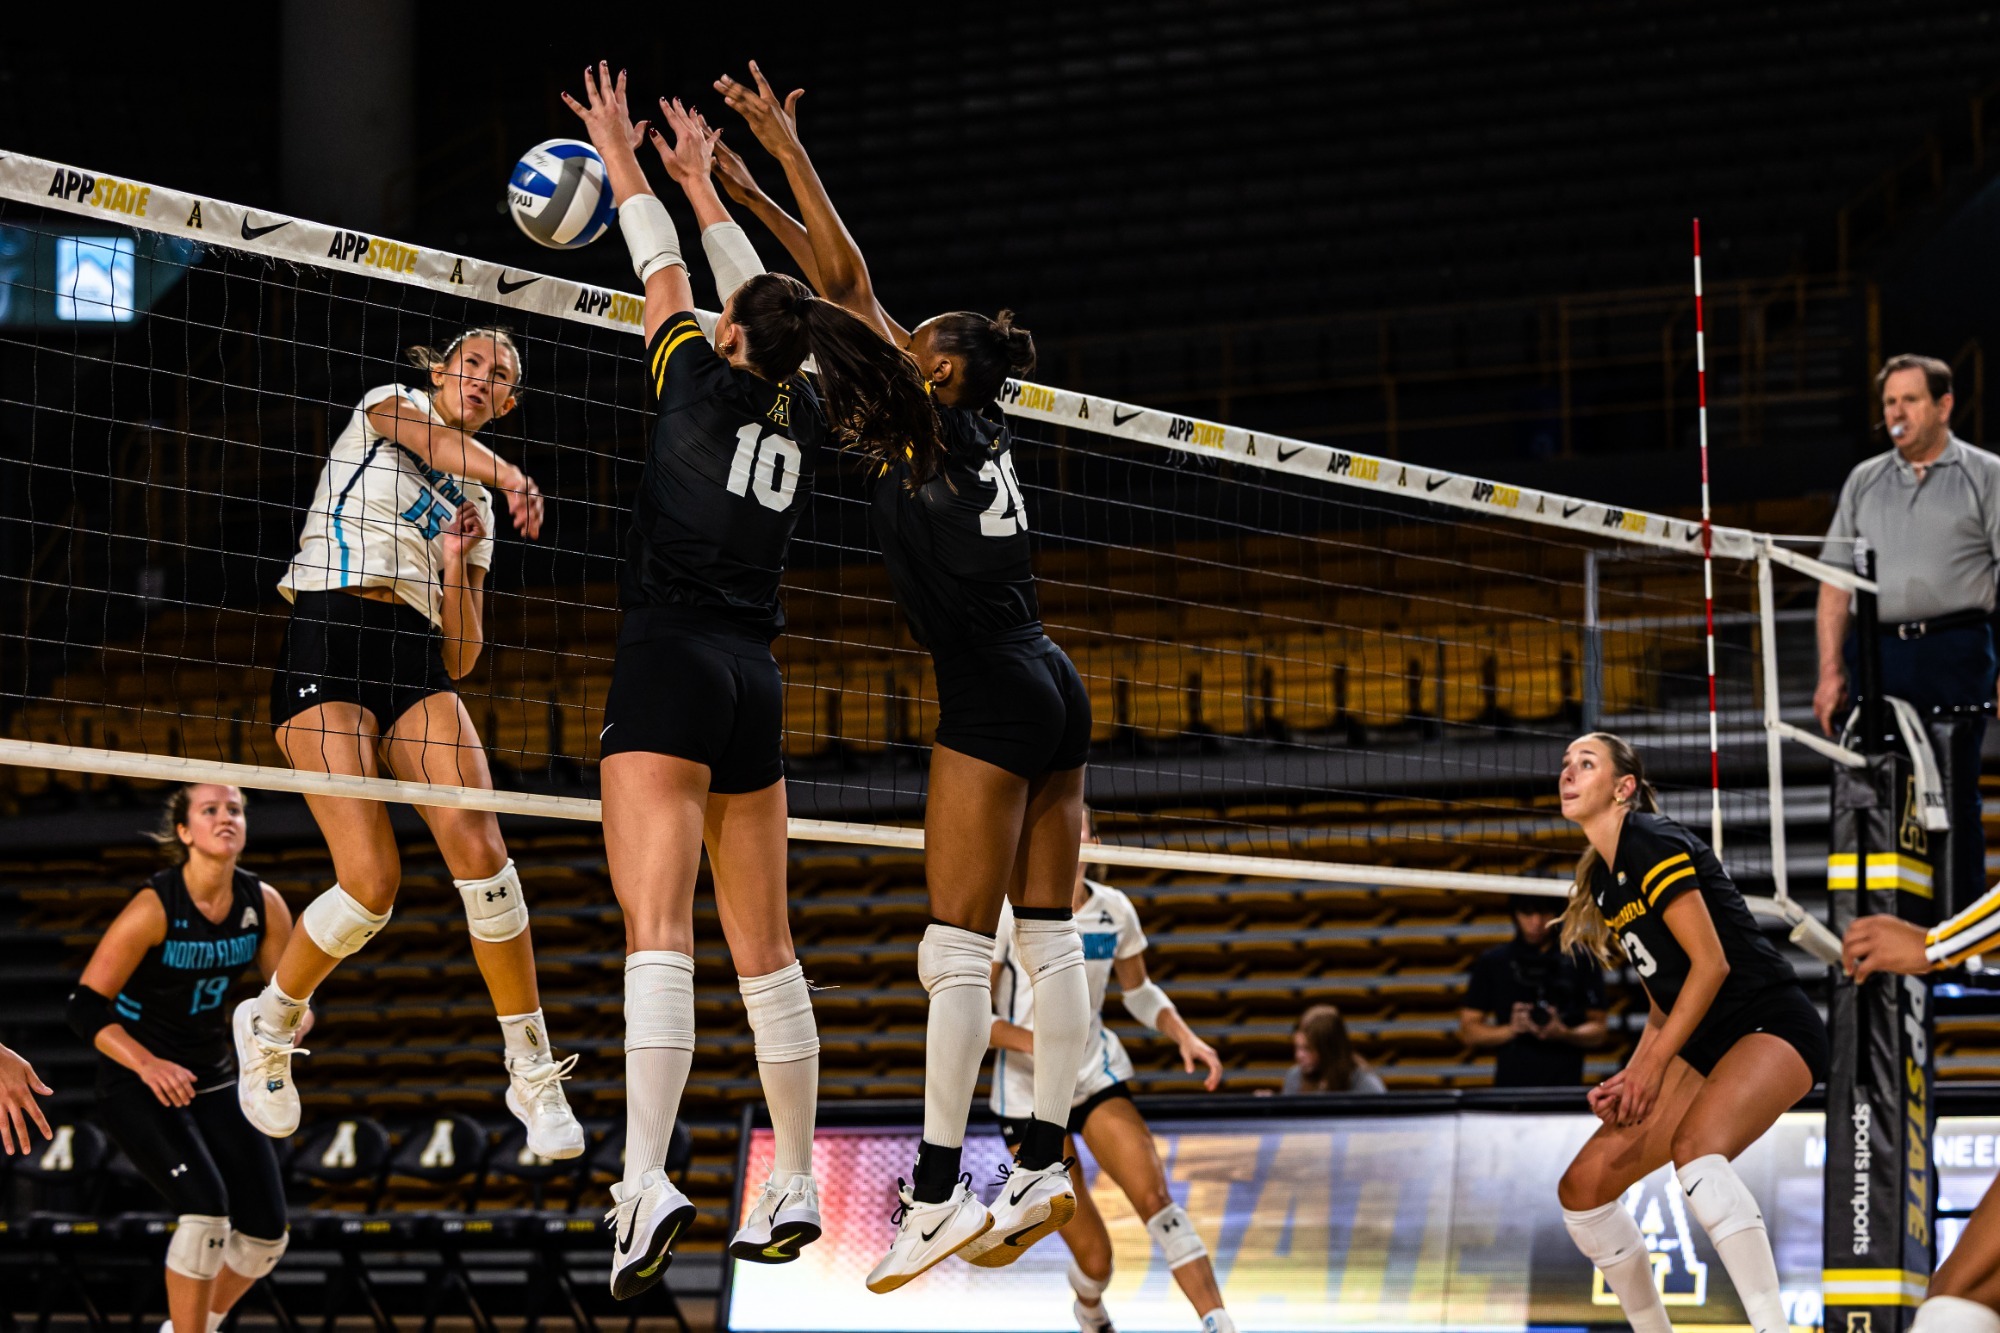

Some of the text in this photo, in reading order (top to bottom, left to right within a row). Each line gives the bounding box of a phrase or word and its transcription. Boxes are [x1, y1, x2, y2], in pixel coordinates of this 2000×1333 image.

[726, 422, 802, 513] 10
[399, 485, 453, 541] 15
[162, 939, 216, 969] NORTH
[189, 975, 230, 1016] 19
[1850, 1103, 1873, 1256] sports imports
